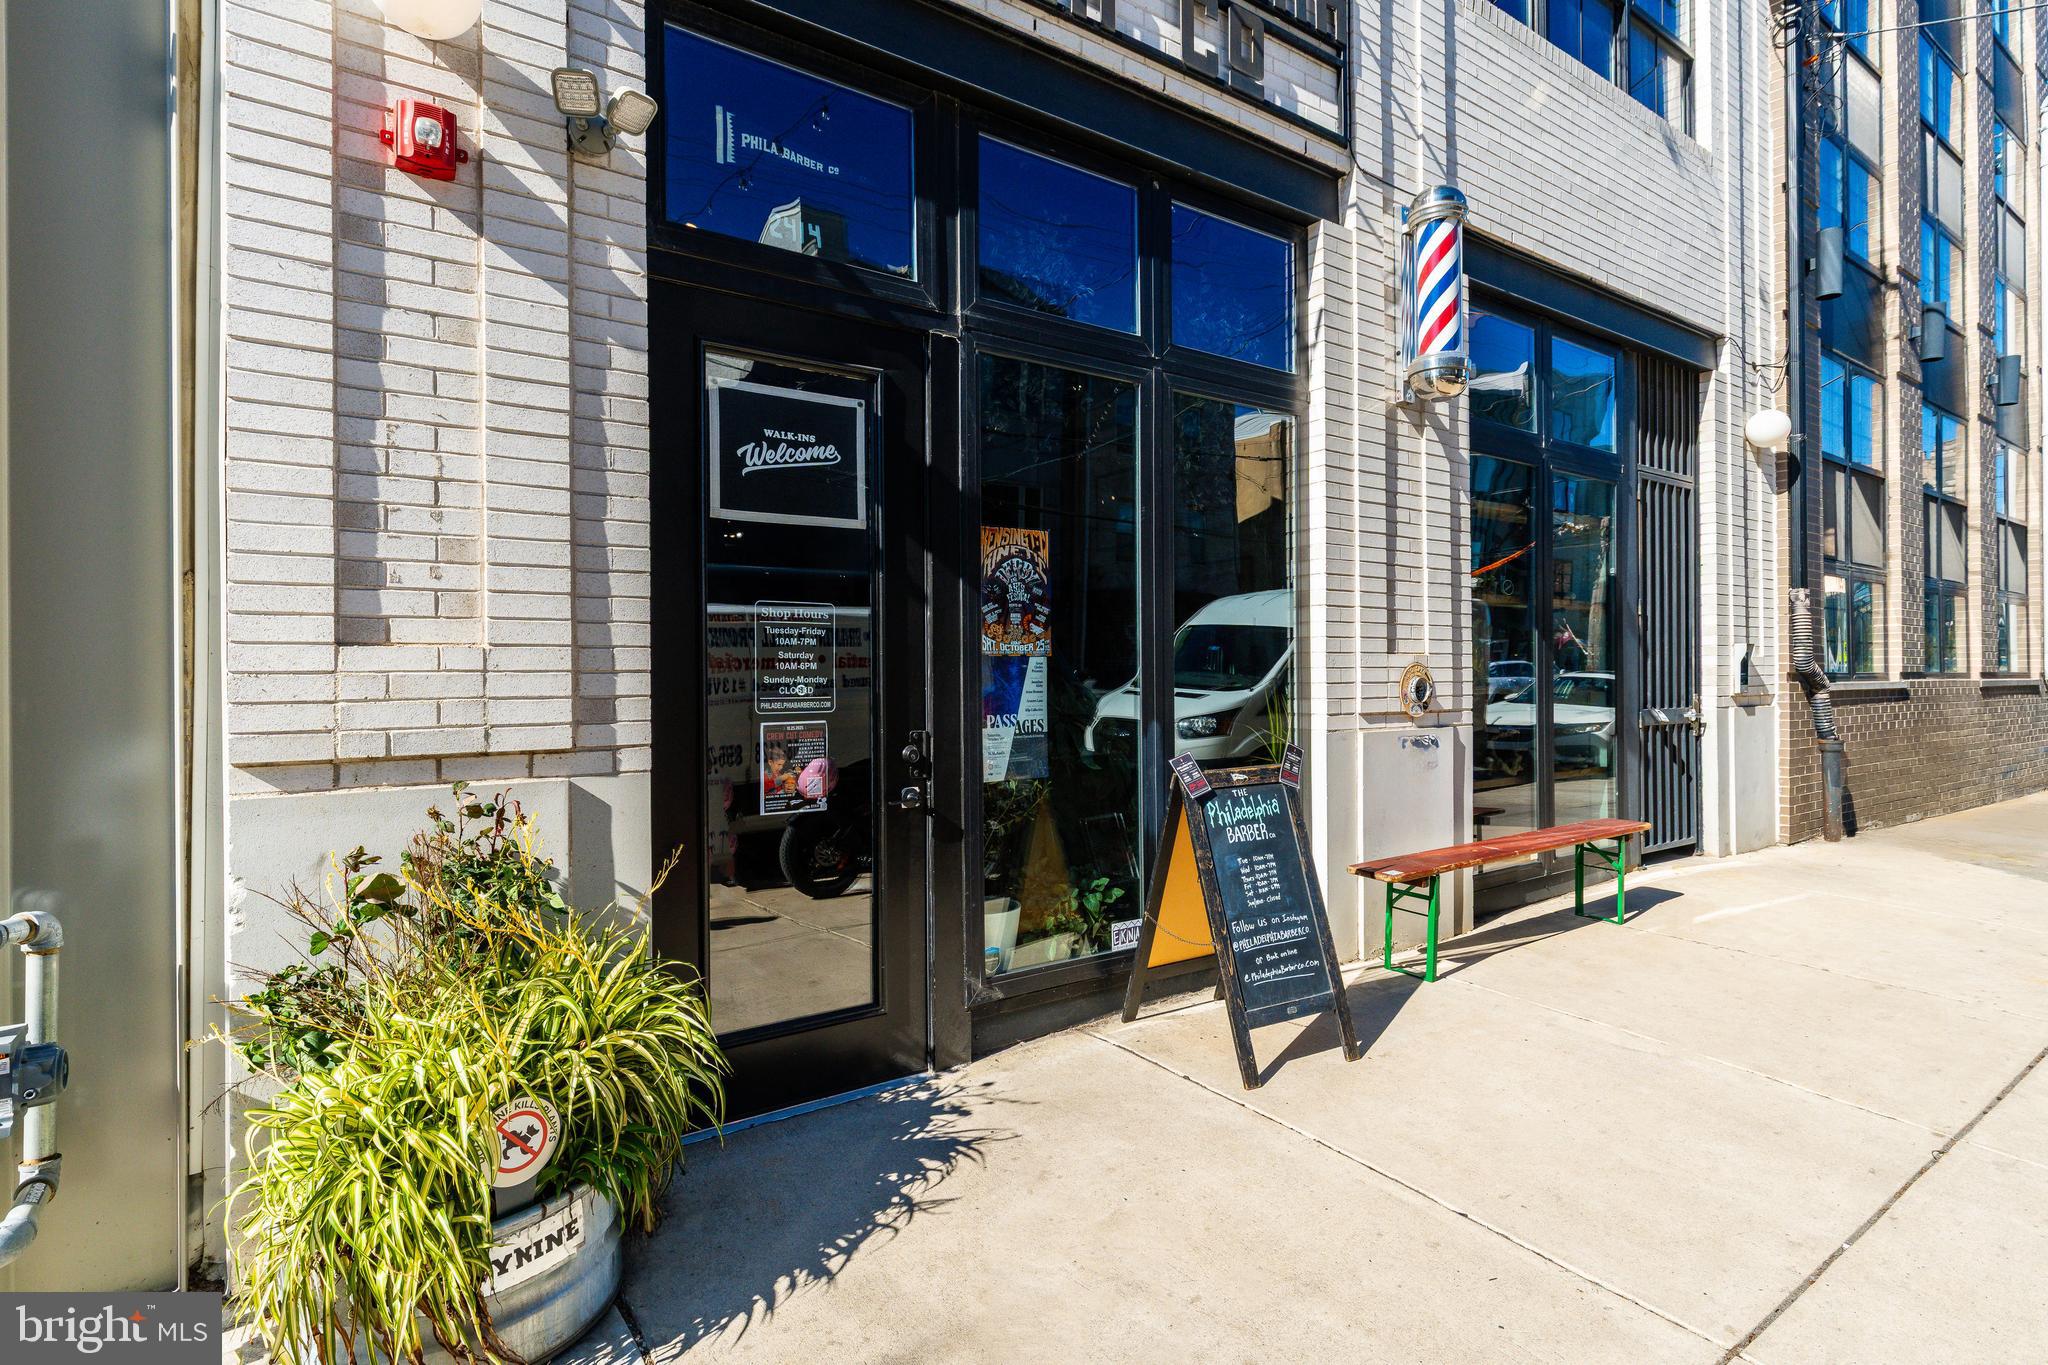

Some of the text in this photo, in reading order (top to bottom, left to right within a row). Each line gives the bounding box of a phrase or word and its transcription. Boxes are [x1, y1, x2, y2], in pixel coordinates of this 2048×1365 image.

[781, 147, 824, 173] BARBER
[769, 216, 822, 249] 2414
[763, 428, 816, 443] WALK-INS
[736, 441, 841, 477] Welcome
[761, 607, 791, 620] Shop
[793, 608, 829, 619] Hours
[764, 626, 827, 637] Tuesday-Friday
[775, 638, 817, 646] 10AM-7PM
[1000, 642, 1034, 652] OCTOBER
[778, 651, 814, 660] Saturday
[775, 662, 817, 670] 10AM-6PM
[763, 676, 828, 686] Sunday-Monday
[778, 686, 814, 696] CLOSED
[760, 702, 832, 710] PHILADELPHIABARBERCO.COM
[766, 730, 824, 741] CREW CUT COMEDY
[1232, 788, 1249, 797] THE
[1206, 794, 1281, 828] Philadelphia
[1226, 822, 1269, 844] BARBER
[1231, 919, 1255, 934] Follow
[1255, 957, 1264, 965] or
